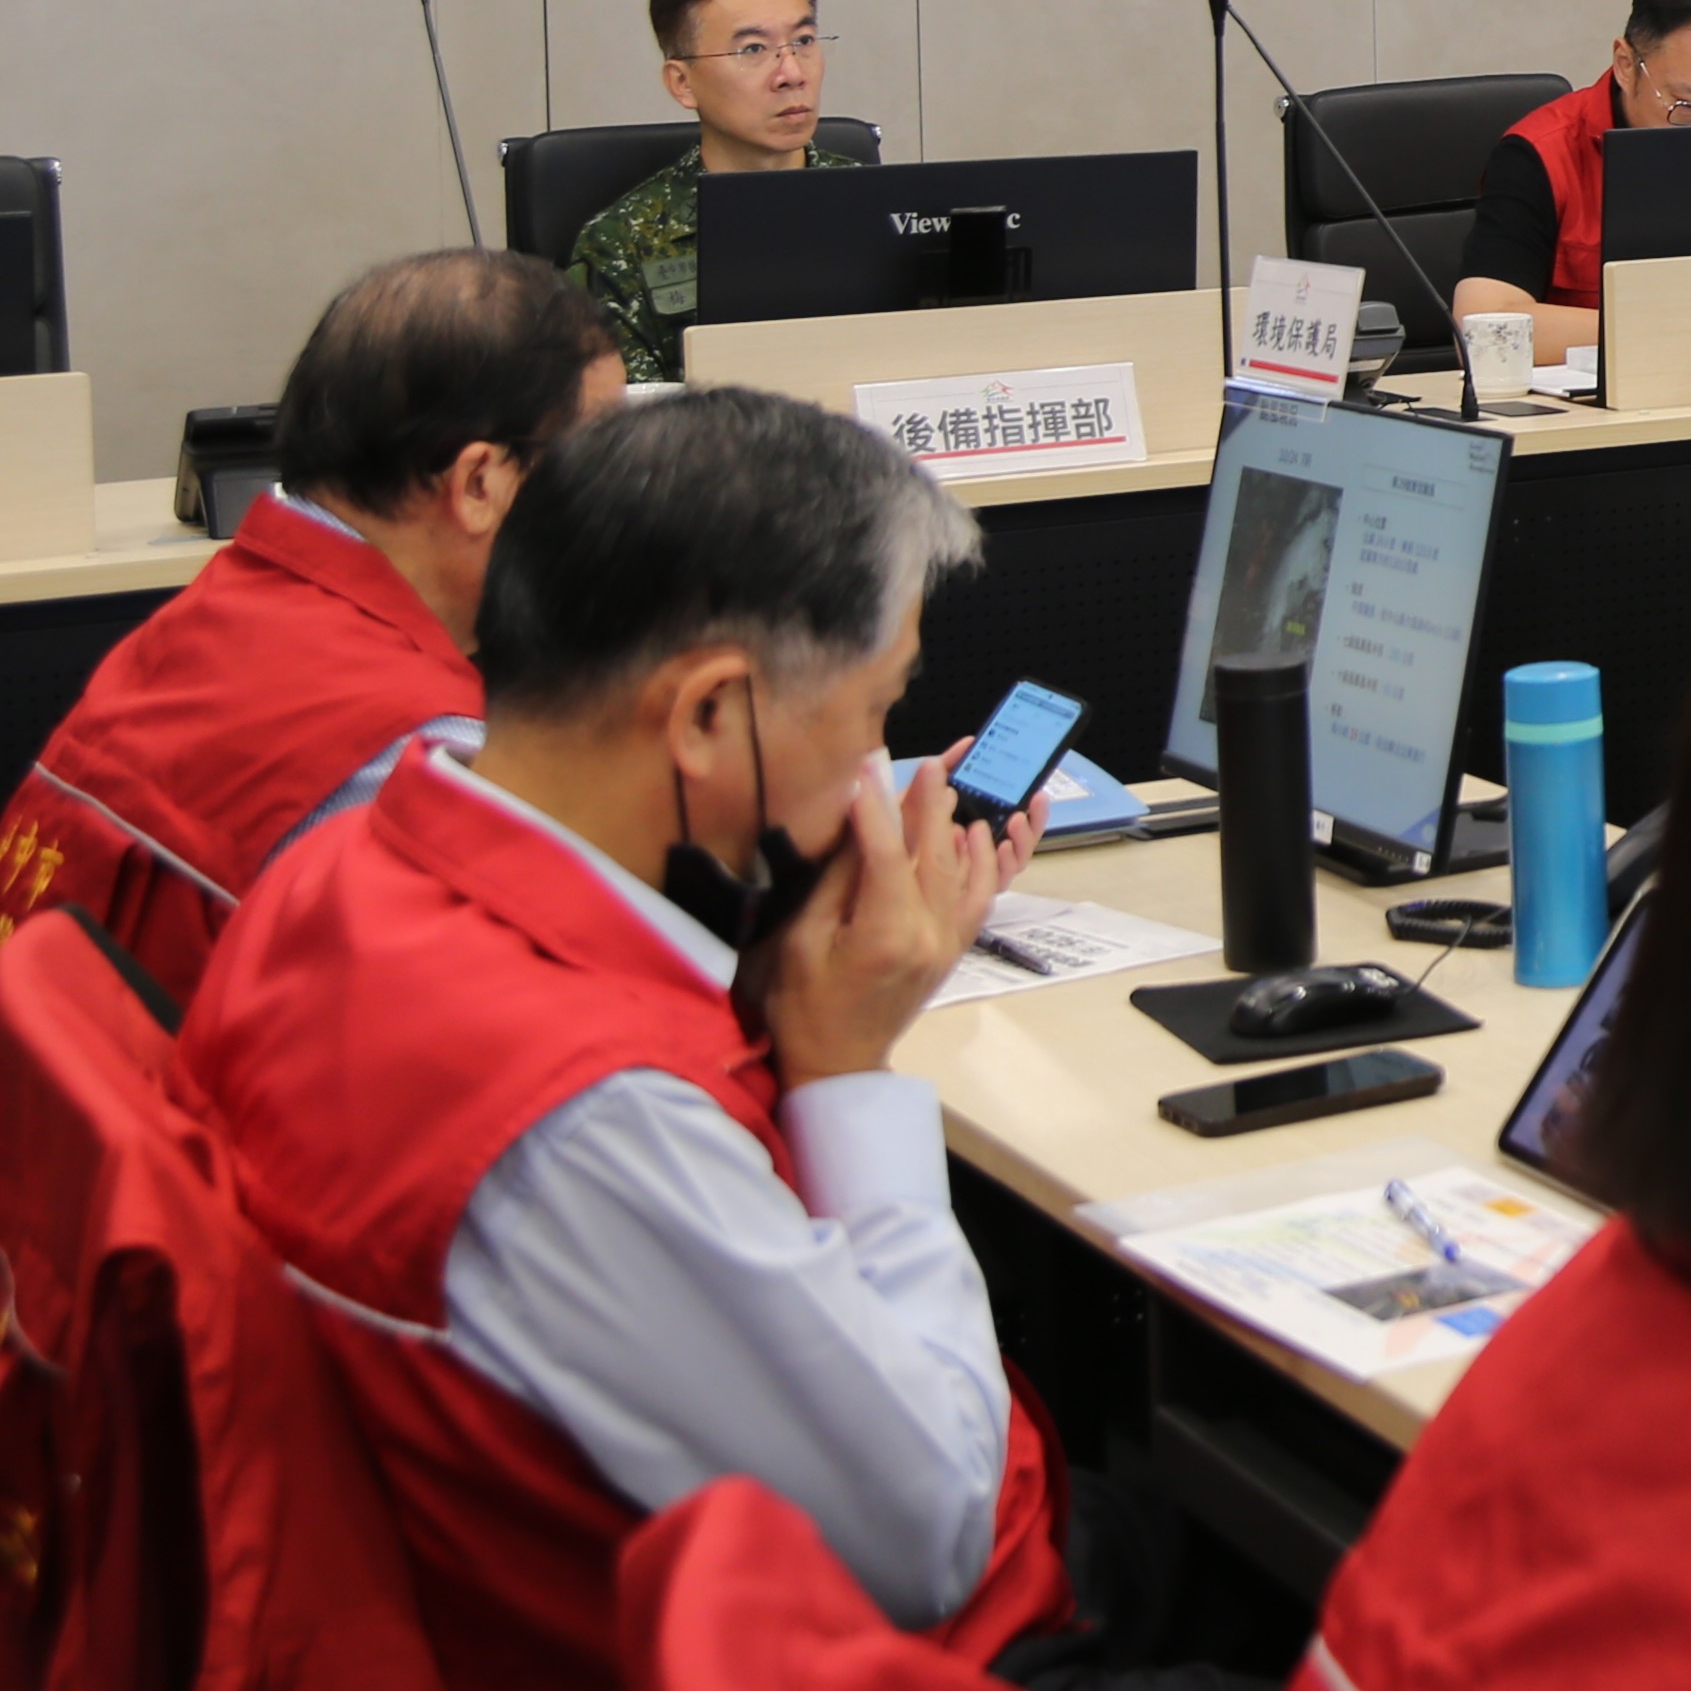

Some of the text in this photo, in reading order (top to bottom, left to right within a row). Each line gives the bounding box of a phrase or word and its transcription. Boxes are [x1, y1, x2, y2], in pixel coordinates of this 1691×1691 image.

[889, 211, 1021, 235] Viewc
[1252, 310, 1338, 360] 環境保護局
[891, 397, 1114, 454] 後備指揮部
